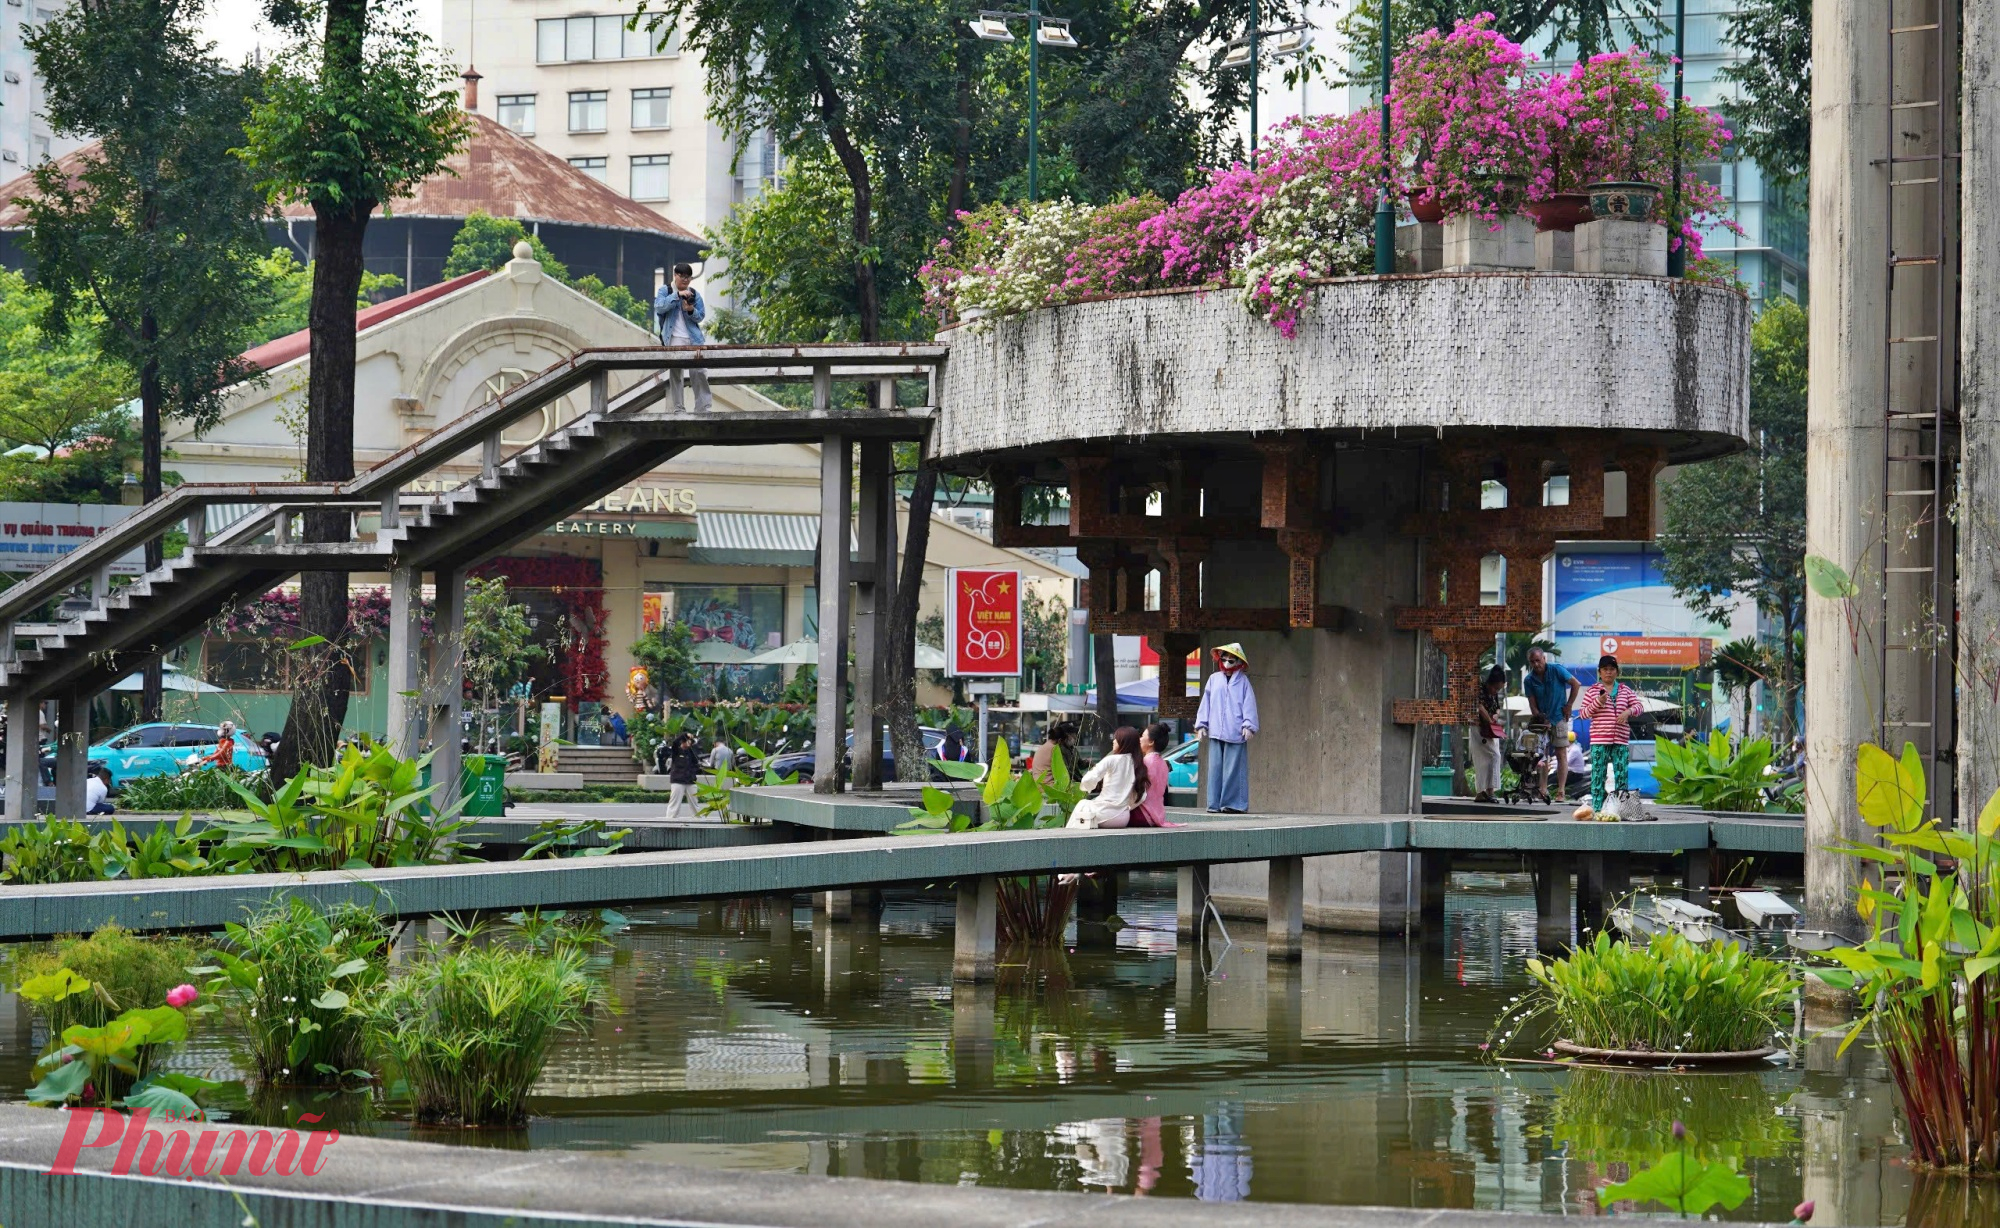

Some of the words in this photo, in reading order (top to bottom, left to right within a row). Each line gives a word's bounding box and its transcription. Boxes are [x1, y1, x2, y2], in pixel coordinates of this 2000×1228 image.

[583, 487, 697, 514] EANS
[4, 523, 18, 537] VỤ
[20, 520, 54, 536] QUẢNG
[57, 522, 95, 538] TRƯỜNG
[556, 521, 636, 534] EATERY
[976, 609, 993, 620] VIỆT
[994, 611, 1011, 620] NAM
[965, 630, 1005, 660] 80
